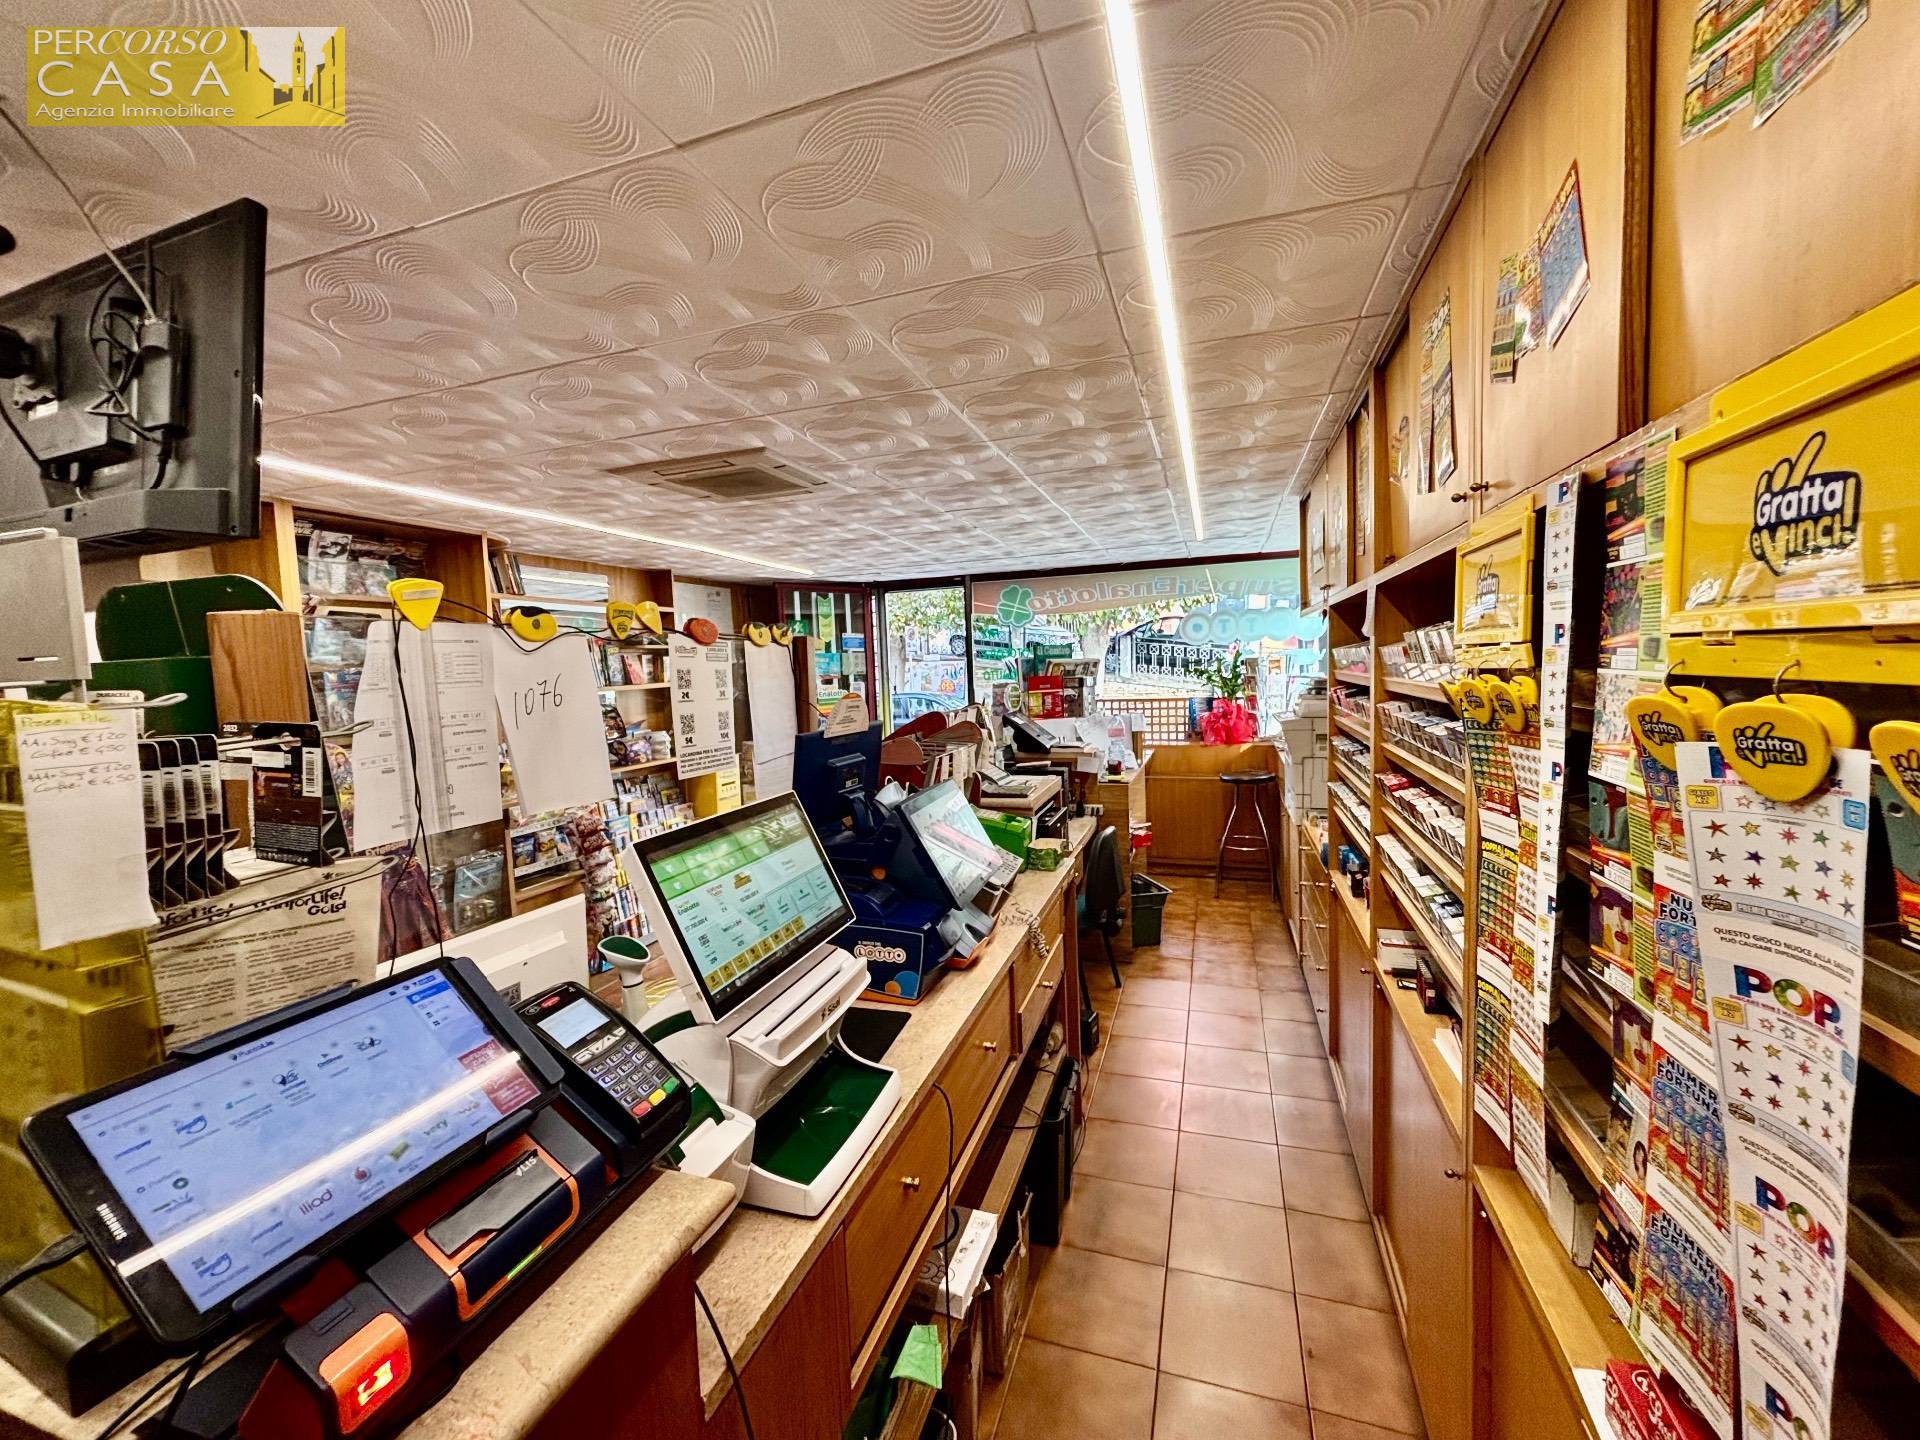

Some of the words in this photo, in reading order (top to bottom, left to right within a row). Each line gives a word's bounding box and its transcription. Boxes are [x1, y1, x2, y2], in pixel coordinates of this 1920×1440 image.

[1757, 477, 1845, 526] Gratta
[1760, 477, 1857, 573] Vinci!
[514, 673, 563, 730] 1076
[1641, 720, 1676, 735] Gratta
[1737, 735, 1795, 752] Gratta
[1658, 903, 1697, 927] FORT
[1669, 892, 1693, 911] NU
[854, 945, 906, 963] LOTTO
[1713, 926, 1750, 939] QUESTO
[1752, 934, 1782, 947] GIOCO
[1783, 942, 1813, 956] NUOCE
[1814, 951, 1831, 964] ALLA
[1738, 939, 1773, 953] CAUSARE
[1774, 947, 1817, 967] DIPENDENZA
[1734, 964, 1841, 1028] POP
[1656, 1064, 1722, 1123] FORTUNA
[1666, 1055, 1719, 1105] NUMER
[300, 1189, 333, 1216] iliad
[1755, 1176, 1835, 1260] POP
[1661, 1210, 1721, 1280] NUMERI
